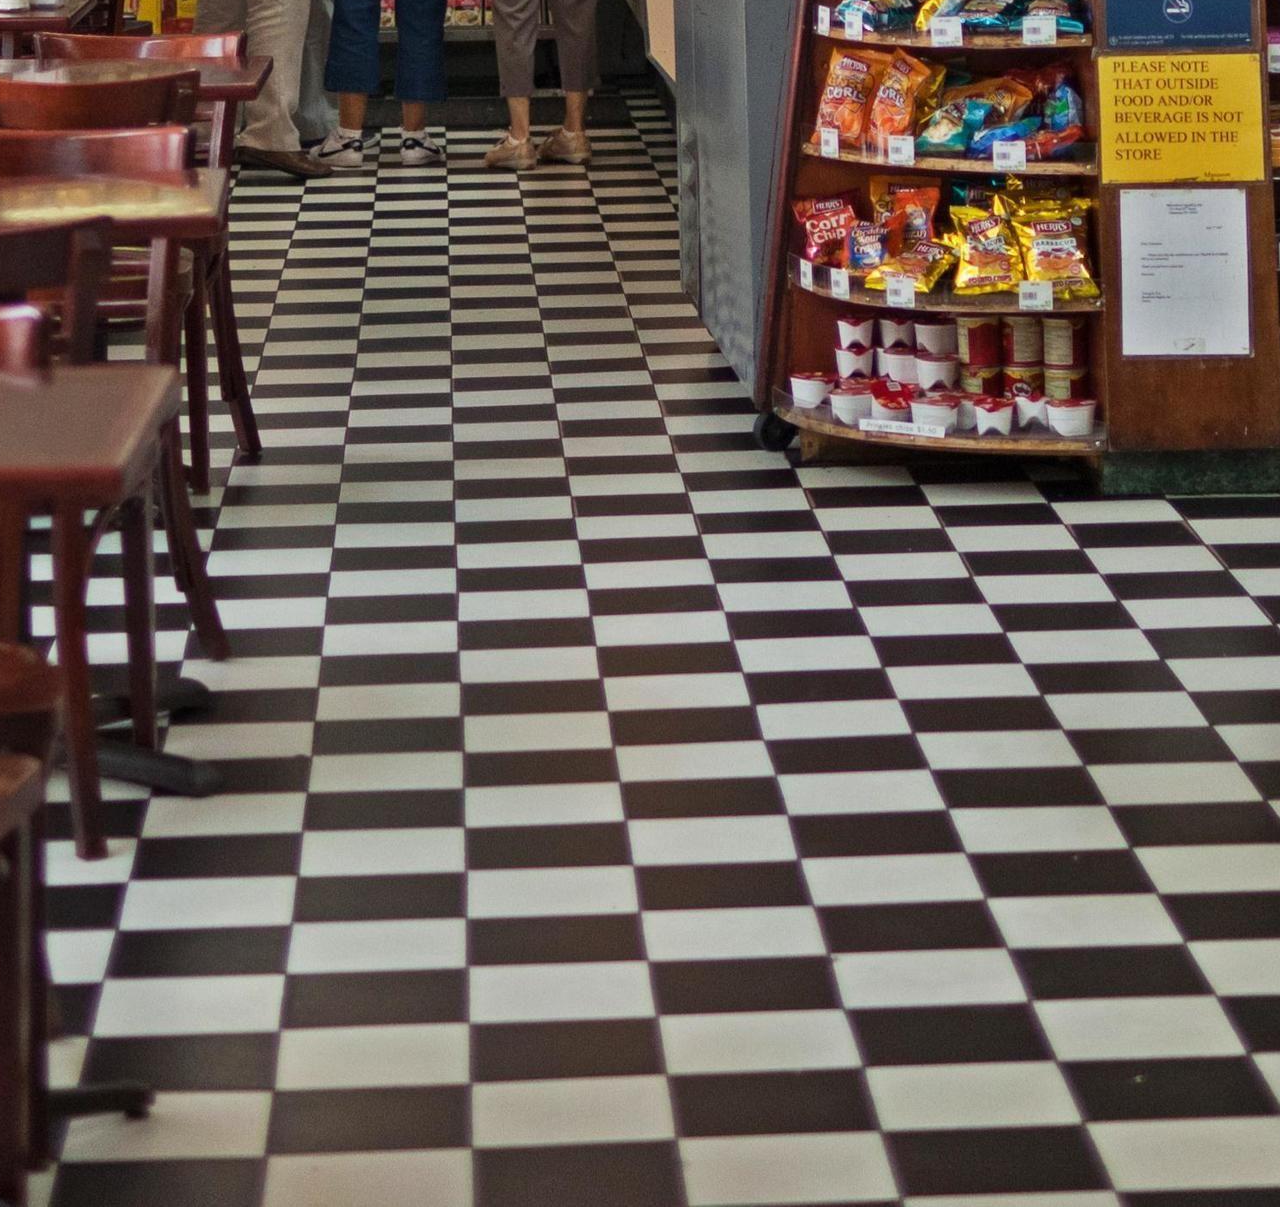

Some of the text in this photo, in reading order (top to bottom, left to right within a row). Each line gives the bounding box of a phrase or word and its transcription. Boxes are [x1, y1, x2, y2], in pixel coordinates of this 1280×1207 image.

[1113, 60, 1209, 73] PLEASE NOTE
[1113, 78, 1219, 90] THAT OUTSIDE
[1114, 94, 1214, 107] FOOD AND/OR
[1114, 111, 1243, 123] BEVERAGE IS NOT
[1115, 131, 1239, 143] ALLOWED IN THE
[1115, 149, 1162, 161] STORE
[813, 228, 847, 244] Chip
